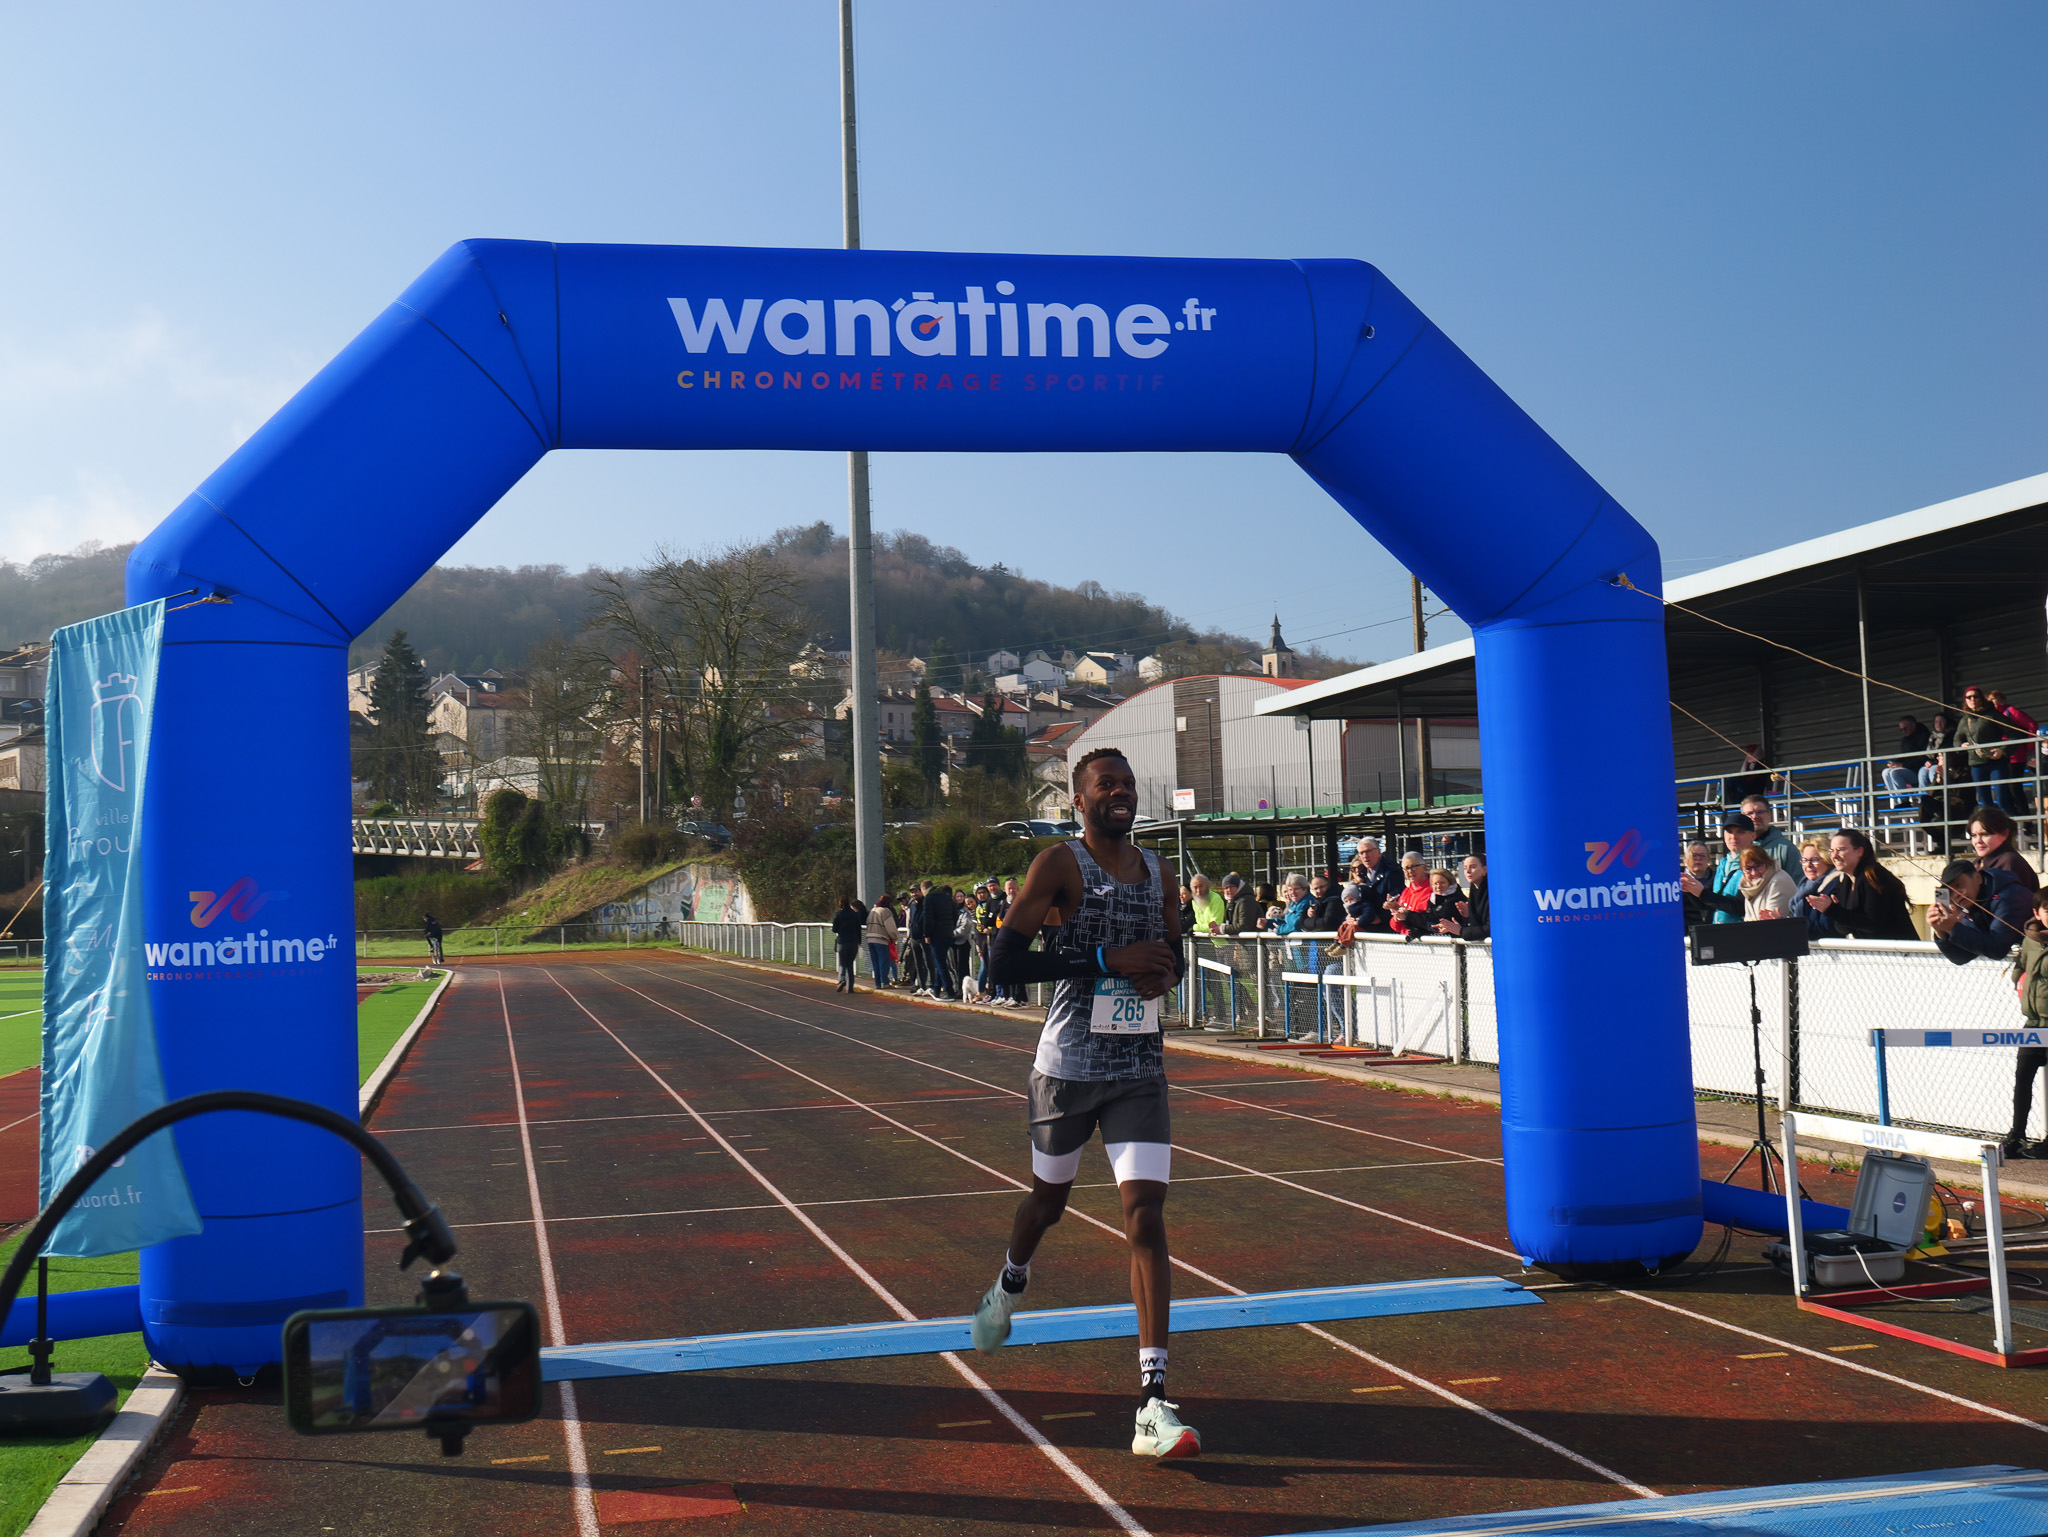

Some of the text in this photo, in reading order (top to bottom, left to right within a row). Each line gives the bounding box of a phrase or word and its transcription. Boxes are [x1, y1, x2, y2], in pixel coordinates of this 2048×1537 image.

[677, 366, 1164, 392] CHRONOMÉTRAGE SPORTIF
[95, 807, 129, 826] ville
[1112, 997, 1145, 1022] 265
[1982, 1032, 2042, 1045] DIMA
[1862, 1129, 1908, 1150] DIMA
